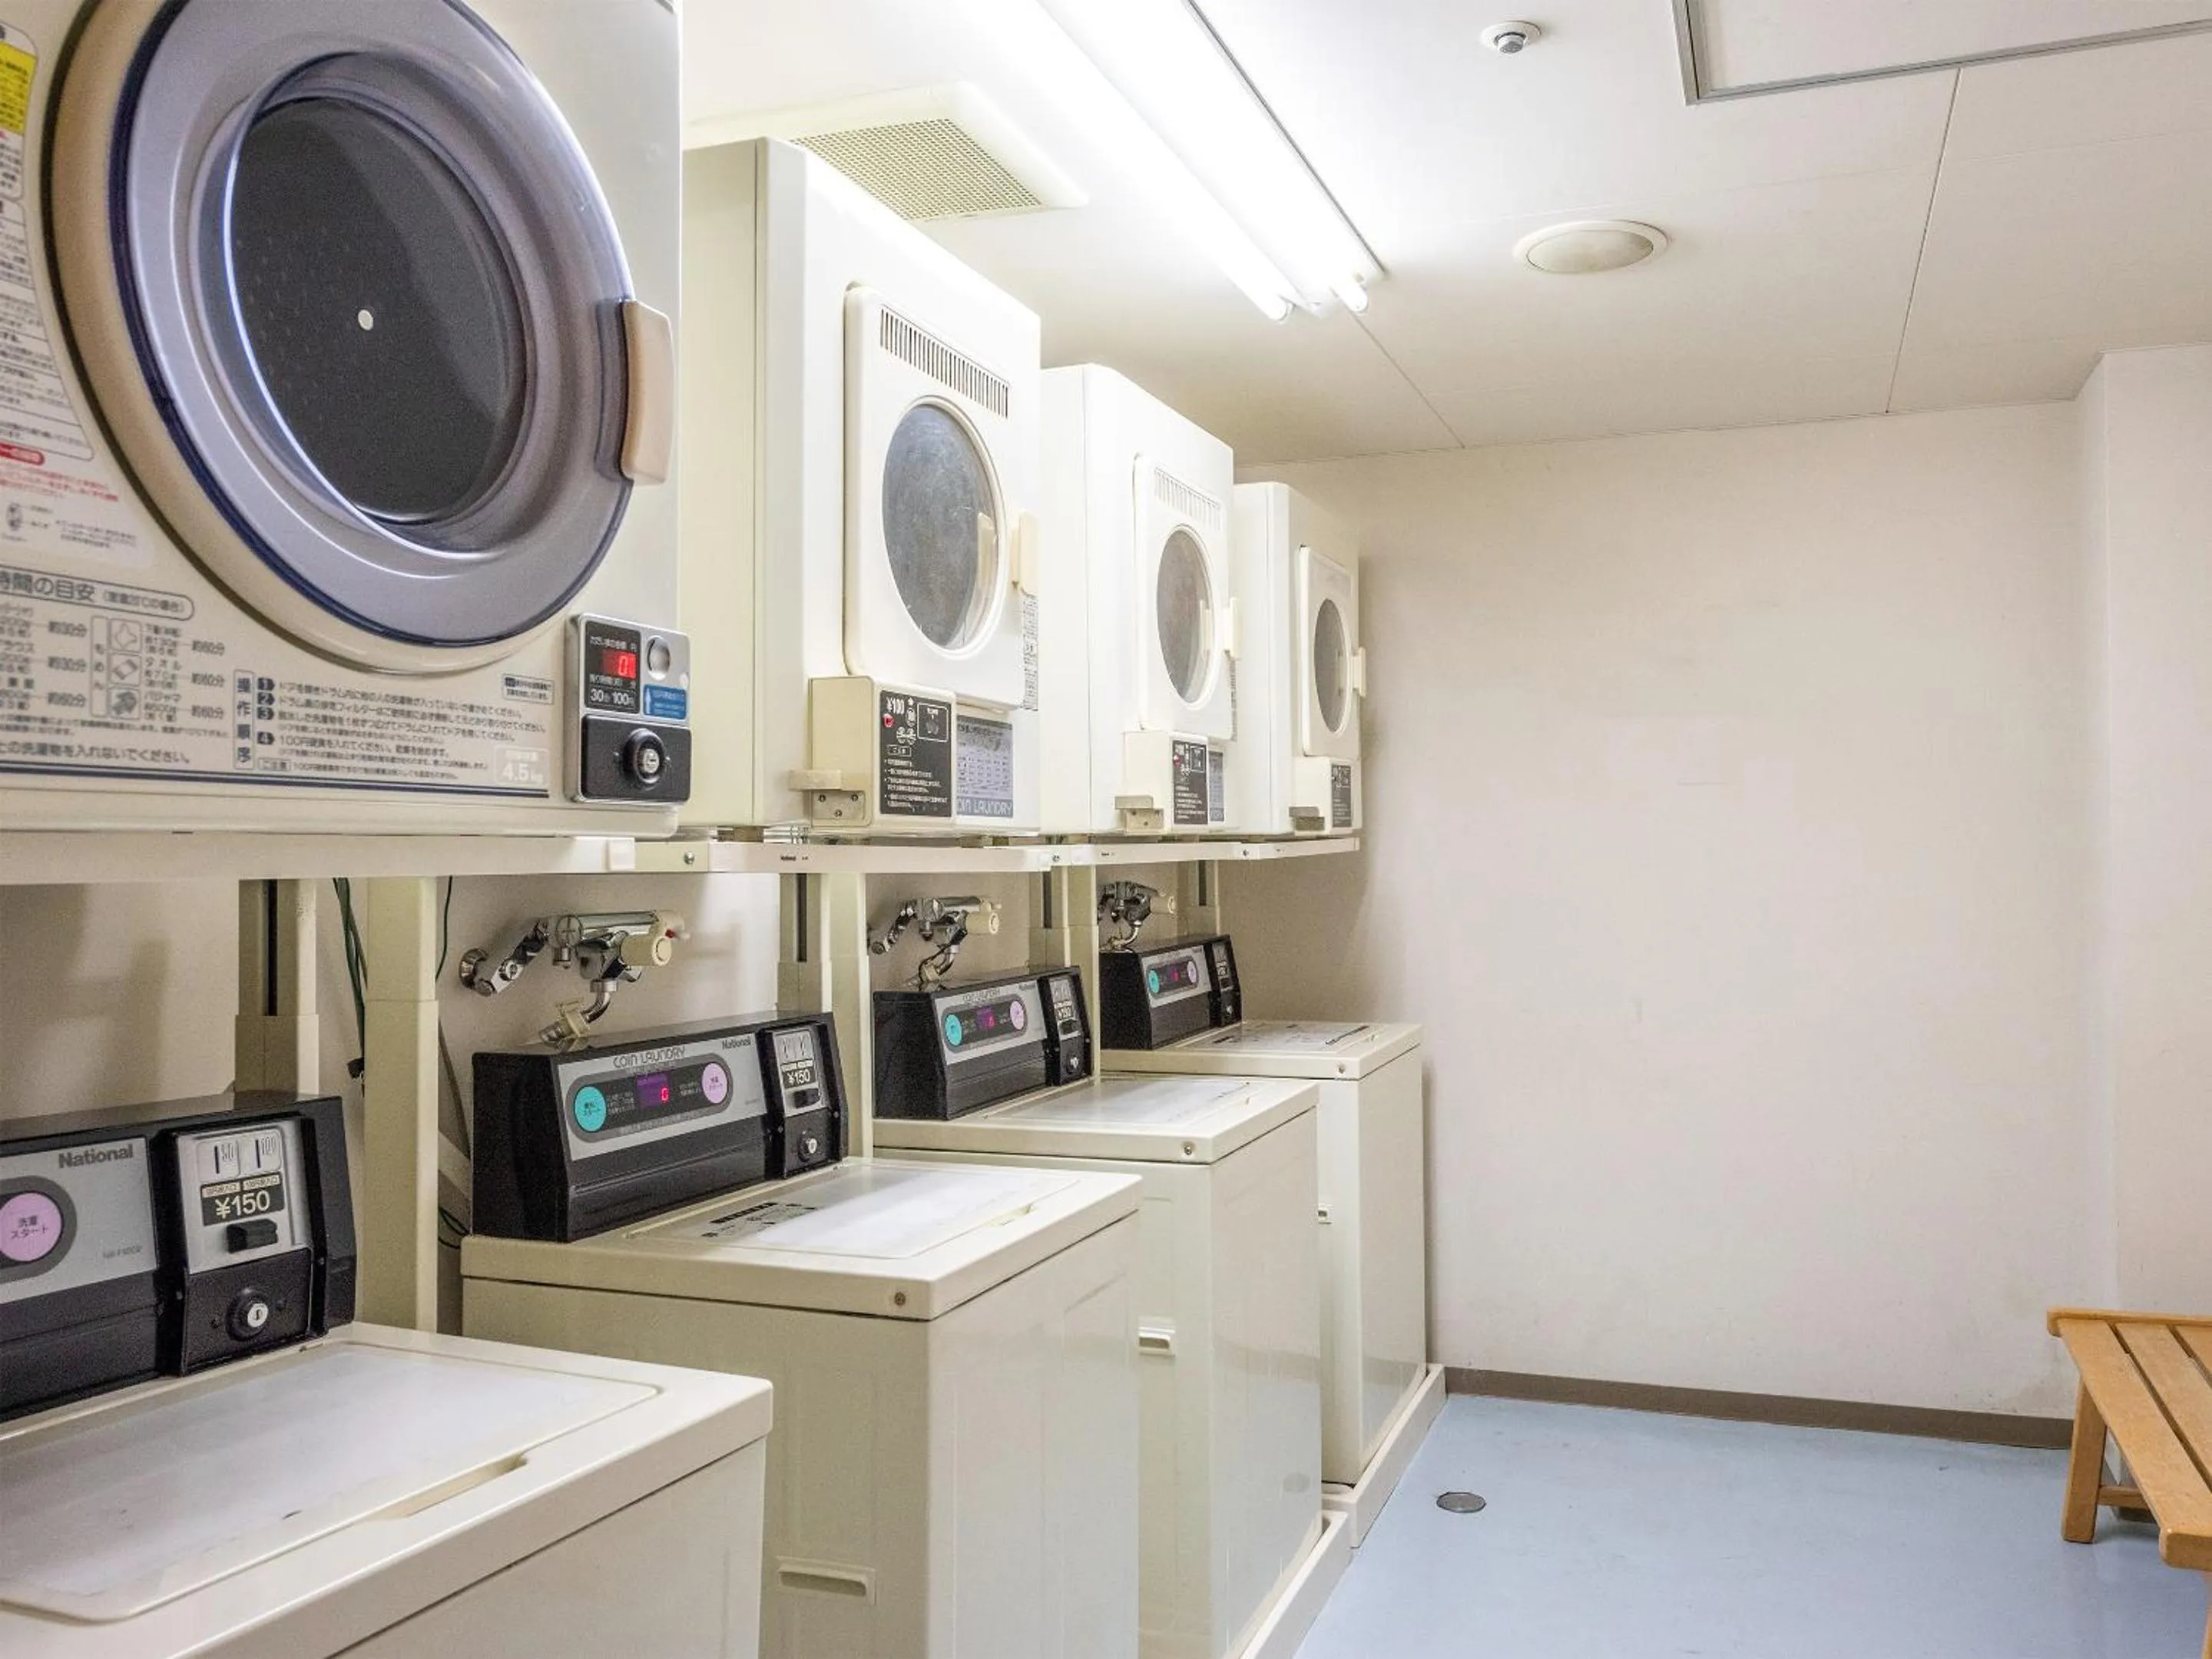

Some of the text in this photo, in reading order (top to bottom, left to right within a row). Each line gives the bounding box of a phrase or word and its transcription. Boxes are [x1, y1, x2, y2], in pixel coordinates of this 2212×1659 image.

[618, 655, 628, 676] 0
[722, 1037, 751, 1050] National
[786, 1068, 811, 1086] ¥150
[58, 1144, 133, 1168] National
[214, 1190, 271, 1219] ¥150
